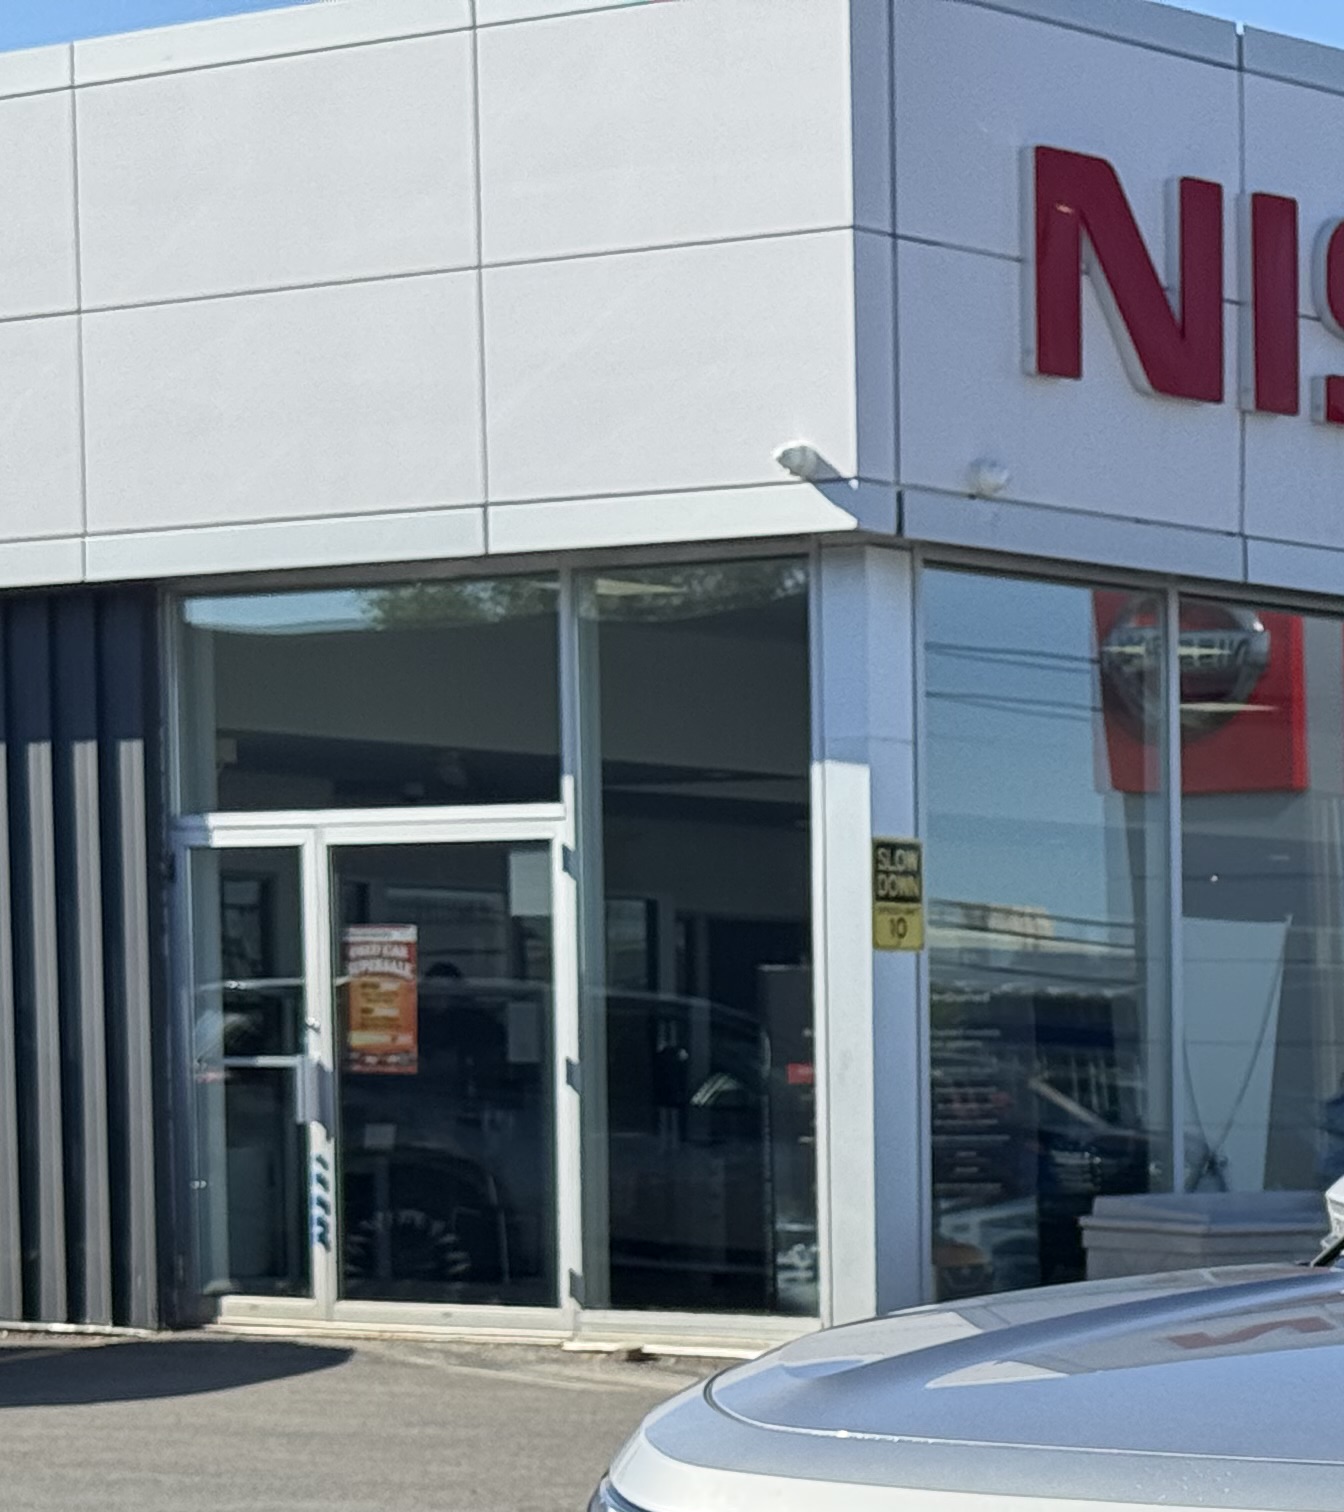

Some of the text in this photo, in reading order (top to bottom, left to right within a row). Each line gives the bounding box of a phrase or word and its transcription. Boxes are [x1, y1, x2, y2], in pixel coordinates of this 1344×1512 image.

[877, 847, 918, 872] SLOW
[877, 873, 919, 897] DOWN
[889, 916, 908, 940] 10
